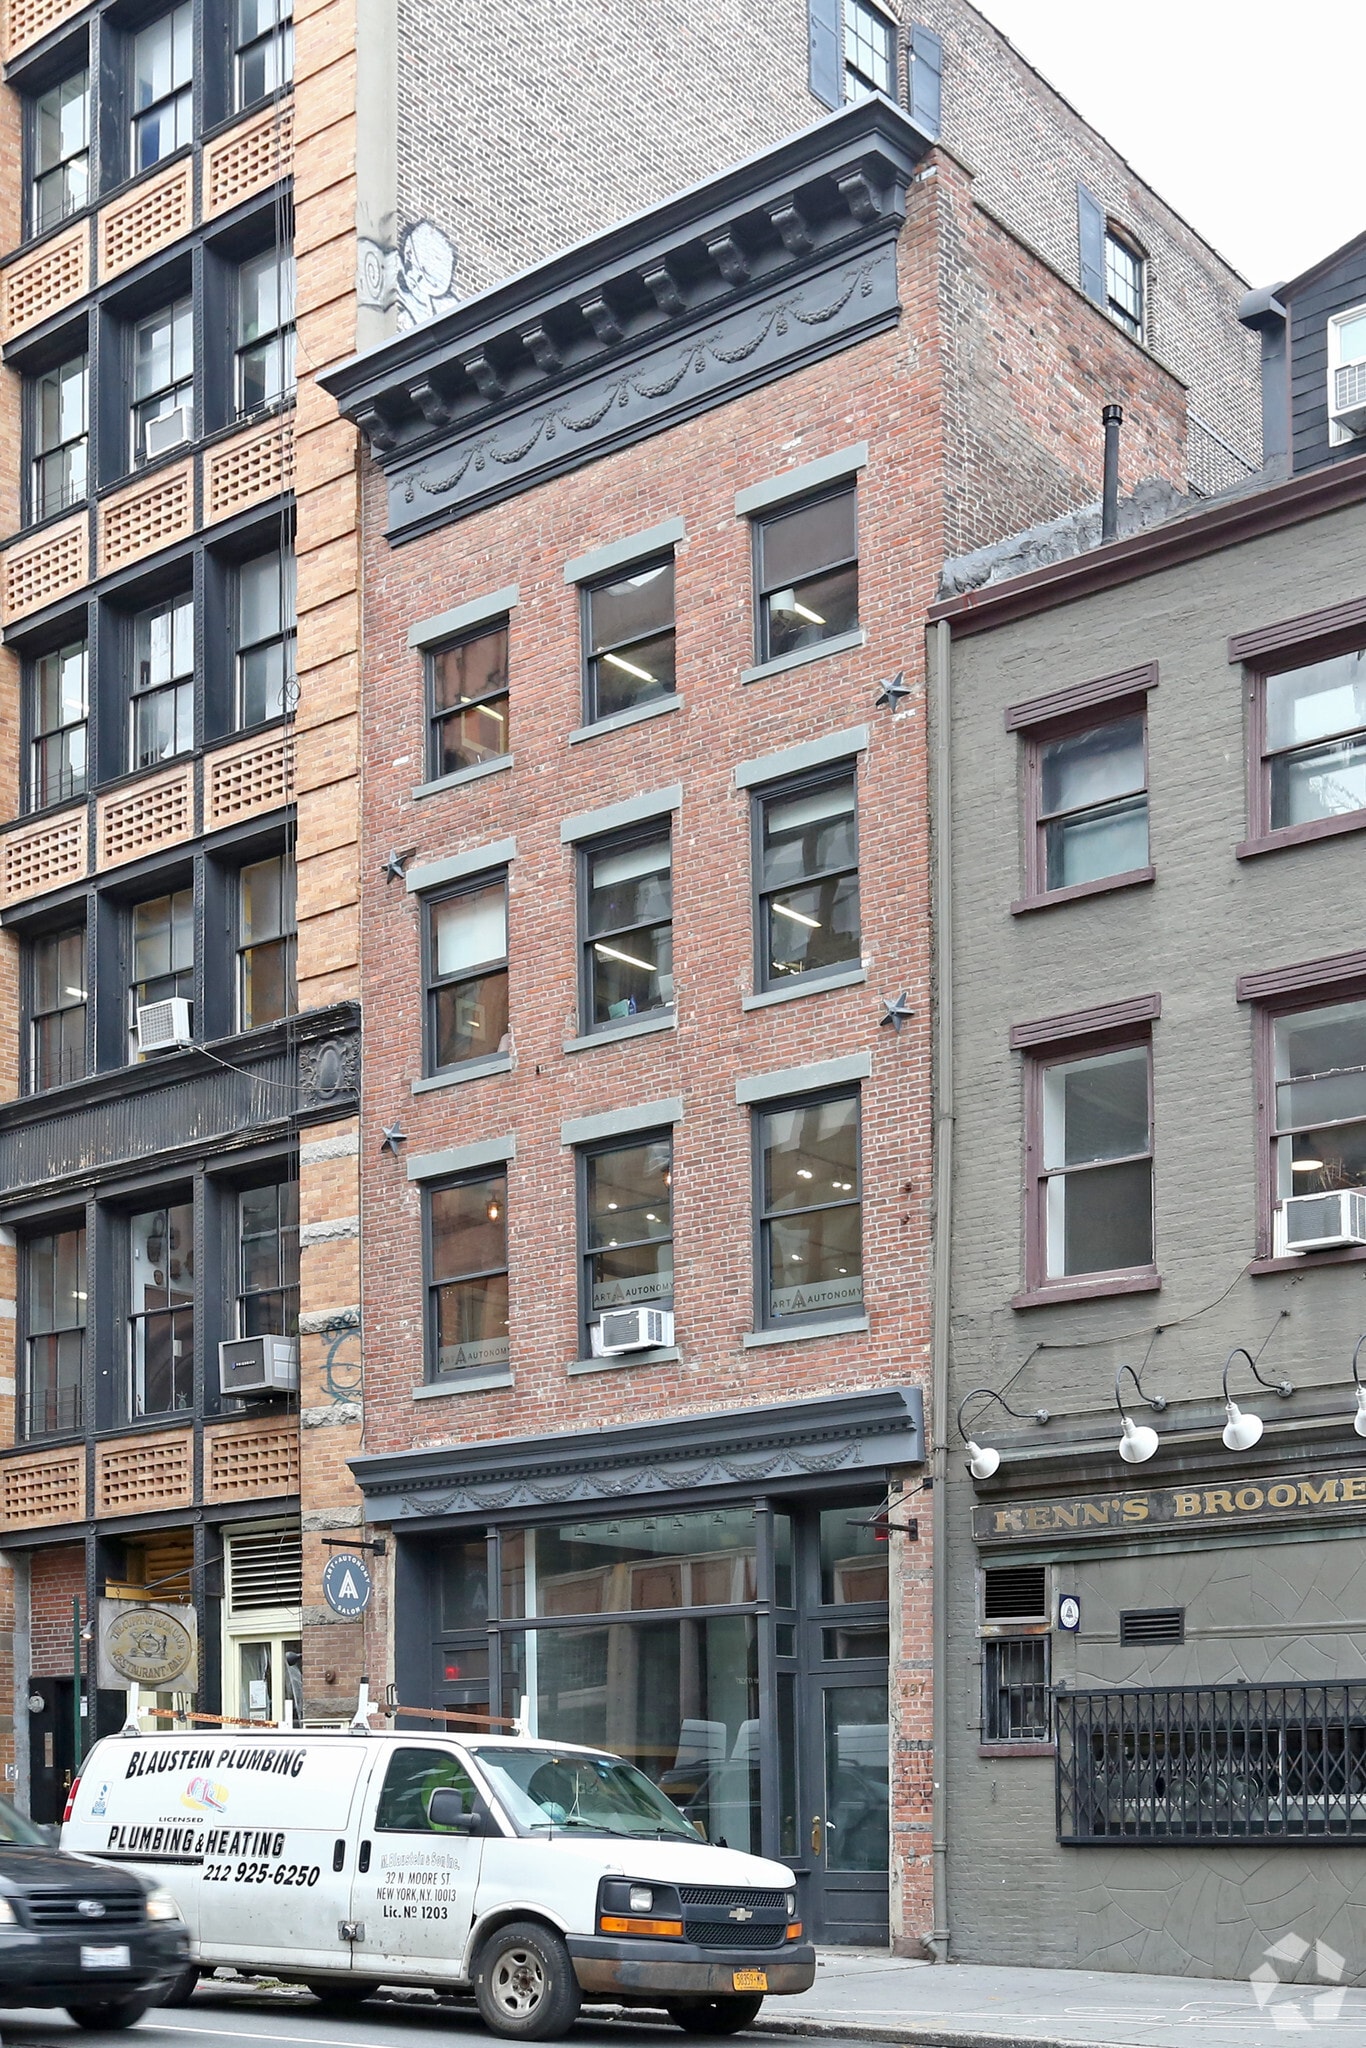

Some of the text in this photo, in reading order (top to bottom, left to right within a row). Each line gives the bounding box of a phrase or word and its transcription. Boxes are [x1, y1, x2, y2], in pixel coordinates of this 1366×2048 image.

[772, 1298, 791, 1309] ART
[807, 1287, 863, 1303] AUTONOMY
[994, 1476, 1366, 1533] KENN'S BROOME
[326, 1555, 371, 1583] ART AUTONOMY
[337, 1604, 361, 1615] SALON
[112, 1648, 167, 1678] RESTAURANT
[901, 1682, 926, 1698] 497
[125, 1748, 307, 1779] BLAUSTEIN PLUMBING
[158, 1816, 204, 1824] LICENSED
[107, 1825, 195, 1854] PLUMBING
[204, 1829, 286, 1859] HEATING
[203, 1862, 320, 1887] 212 925-6250
[384, 1871, 396, 1884] 32
[408, 1872, 438, 1886] MOORE
[376, 1887, 394, 1900] NEW
[434, 1888, 457, 1902] 10013
[383, 1904, 402, 1918] Lic.
[421, 1906, 448, 1920] 1203
